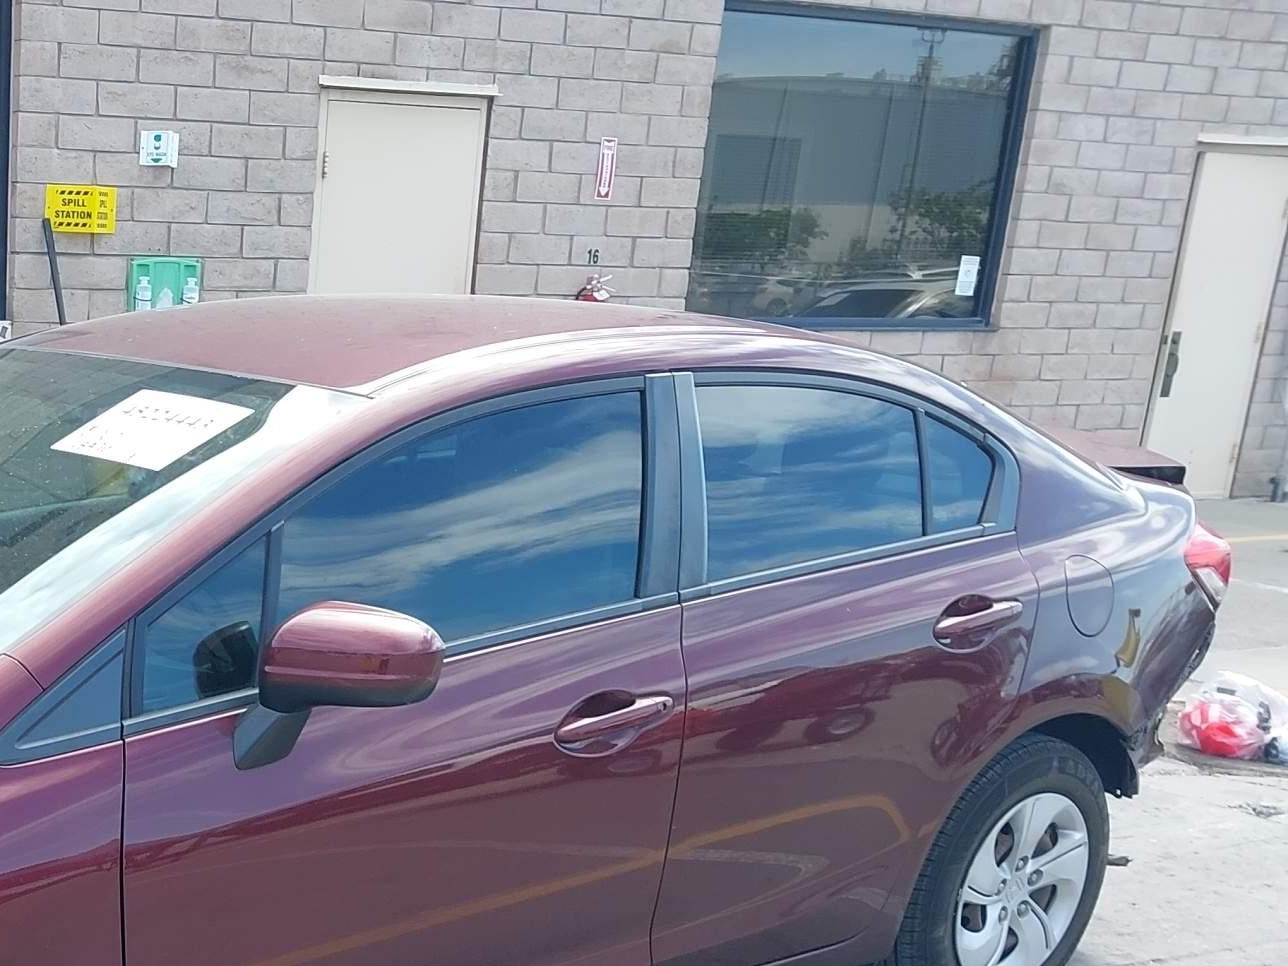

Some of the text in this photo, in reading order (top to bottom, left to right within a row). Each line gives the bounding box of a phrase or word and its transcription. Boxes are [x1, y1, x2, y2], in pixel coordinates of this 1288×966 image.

[61, 198, 87, 208] SPILL
[54, 210, 93, 220] STATION
[587, 248, 600, 265] 16
